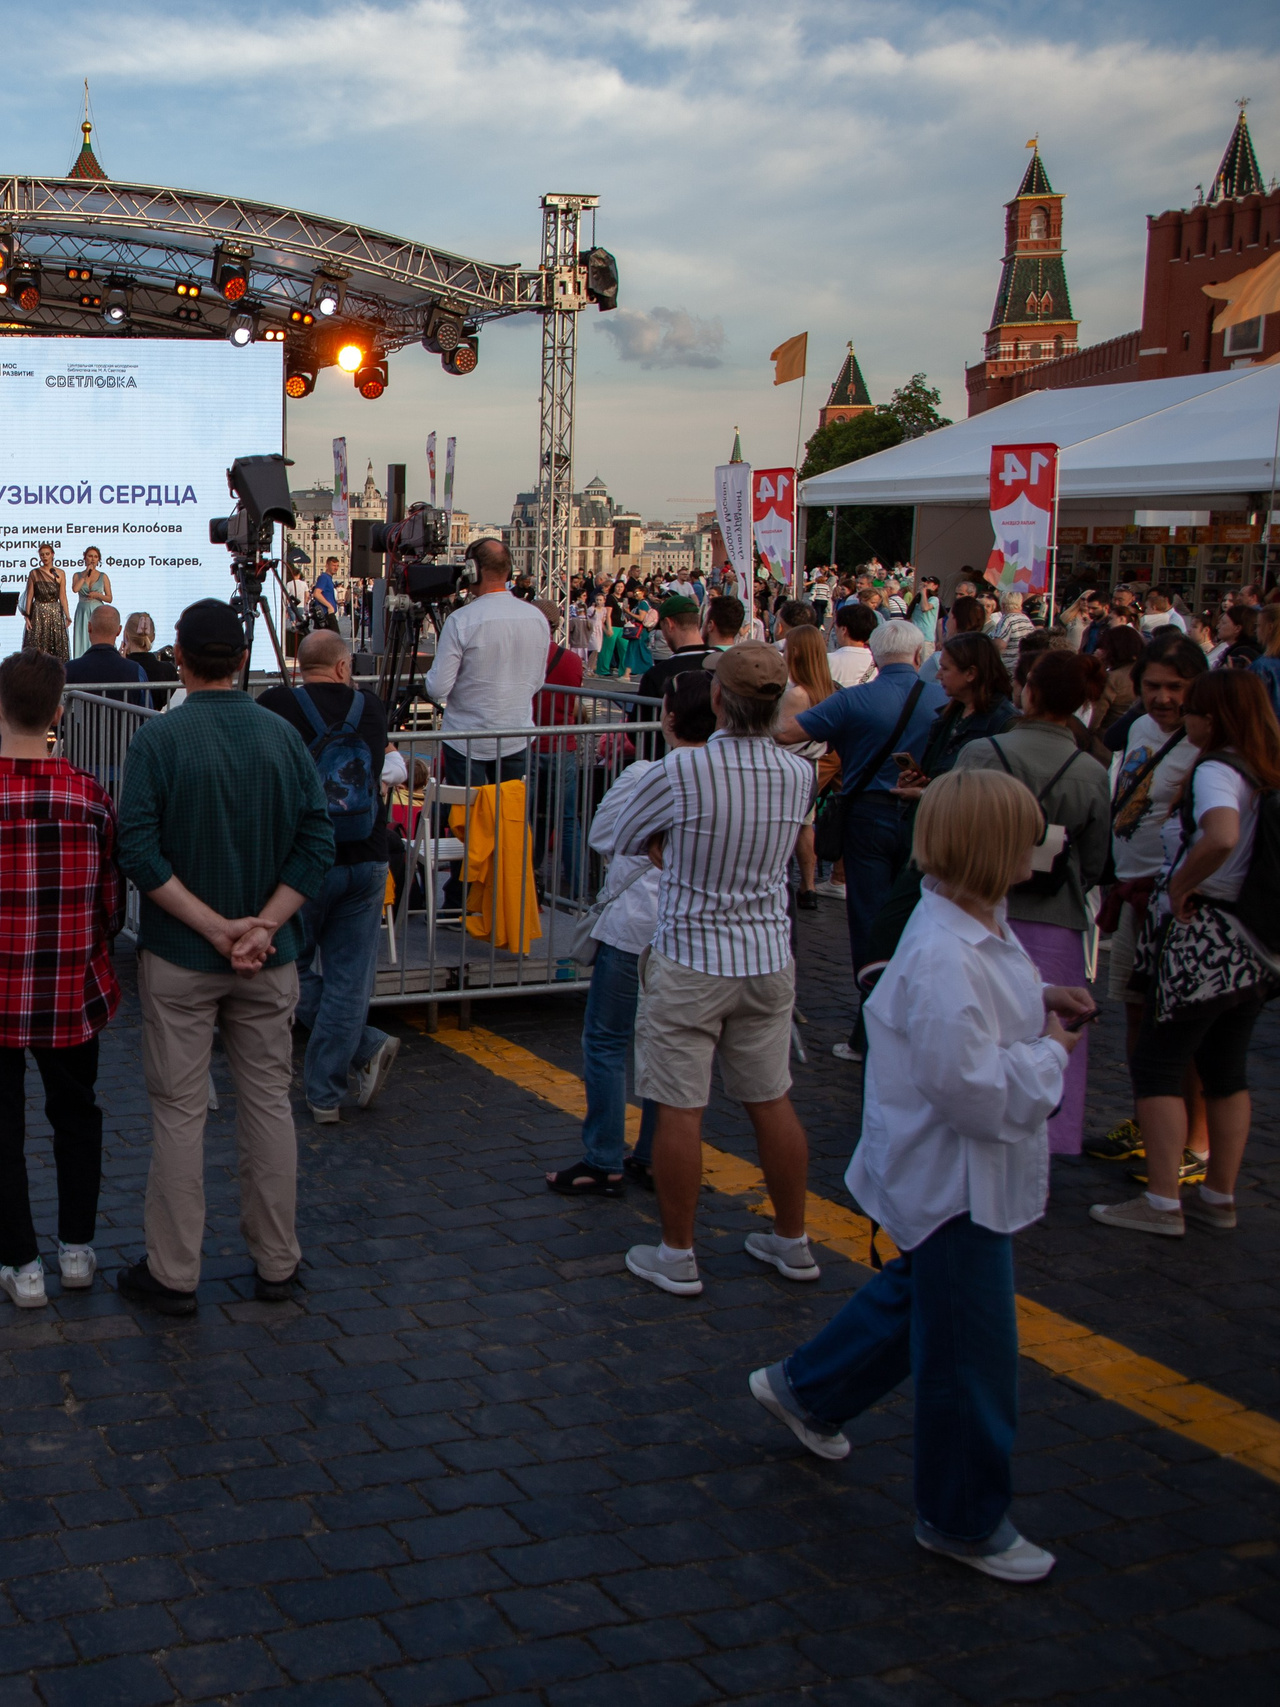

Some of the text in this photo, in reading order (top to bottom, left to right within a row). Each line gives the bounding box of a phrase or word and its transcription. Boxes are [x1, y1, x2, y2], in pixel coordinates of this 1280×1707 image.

[2, 370, 35, 378] РАЗВИТИЕ
[45, 375, 138, 389] СВЕТЛОВКА
[99, 484, 198, 507] СЕРДЦА
[22, 525, 63, 535] имени
[66, 523, 119, 534] Евгения
[122, 521, 183, 533] Колобова
[105, 555, 146, 569] Федор
[148, 555, 203, 568] Токарев,
